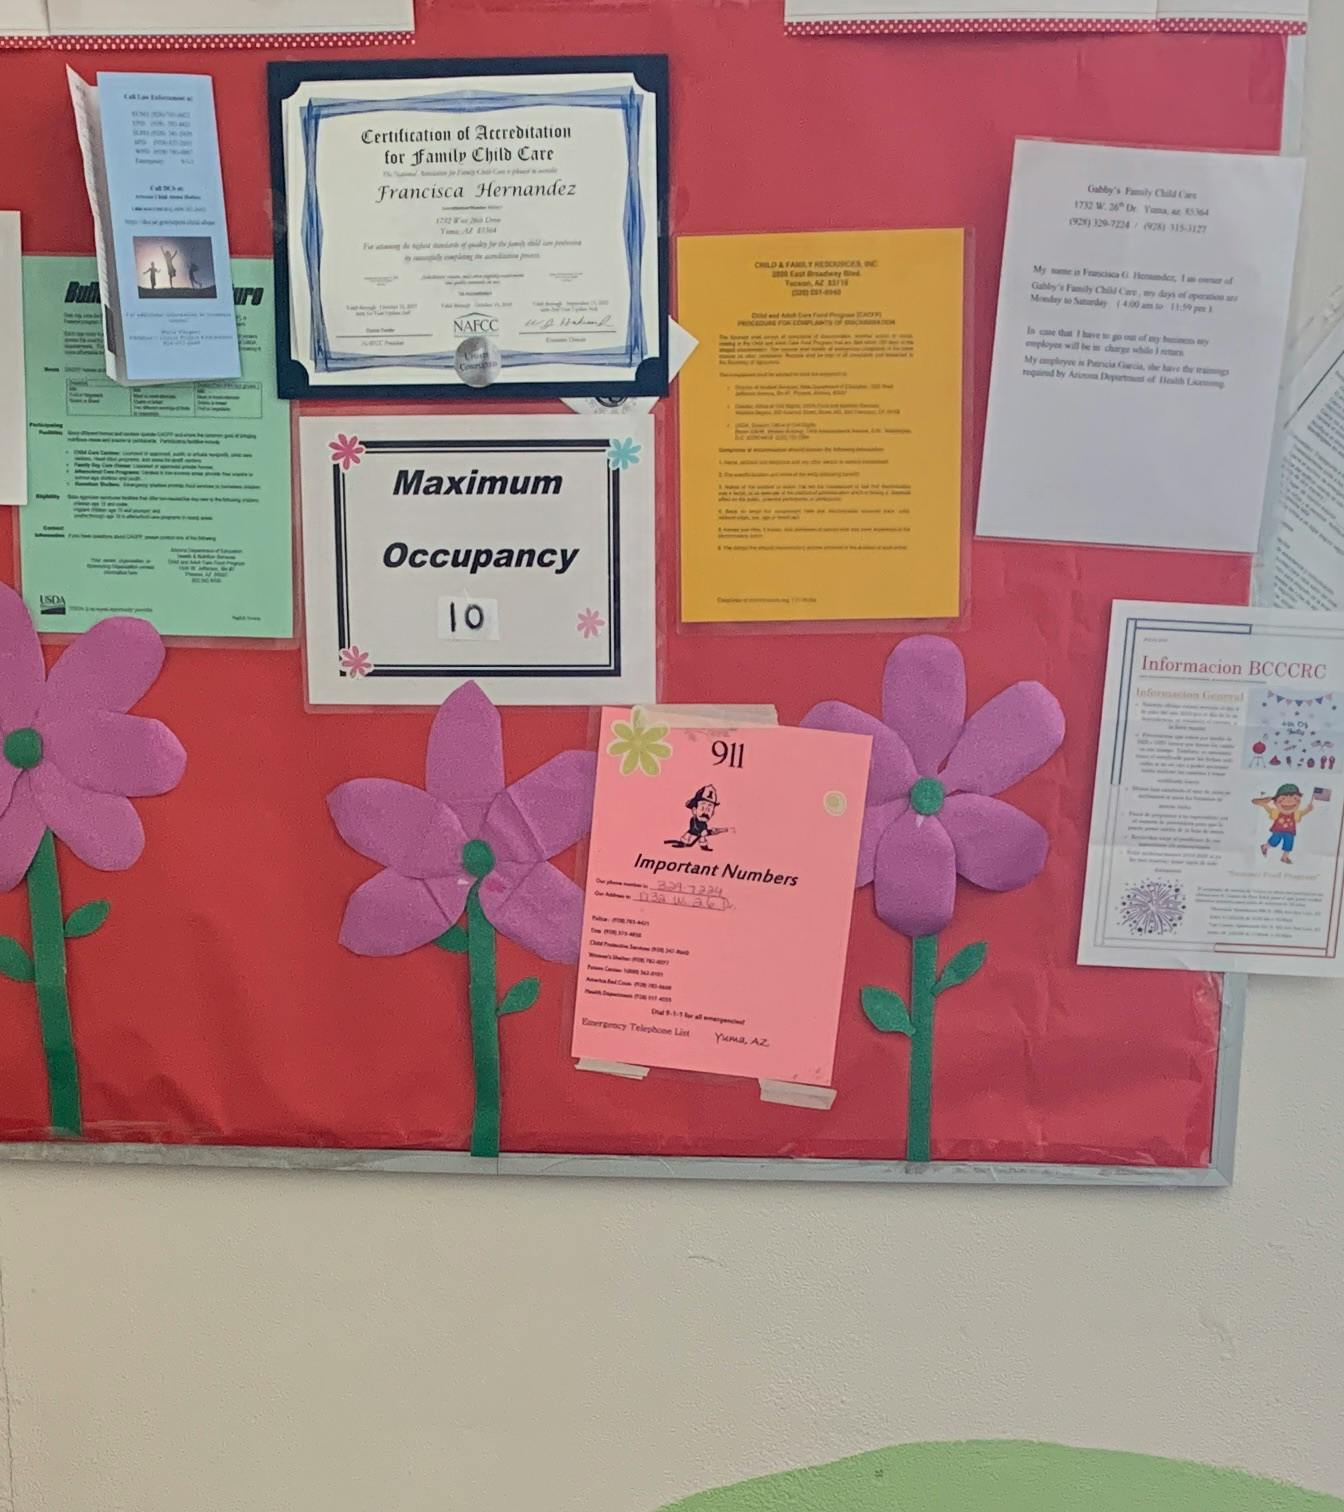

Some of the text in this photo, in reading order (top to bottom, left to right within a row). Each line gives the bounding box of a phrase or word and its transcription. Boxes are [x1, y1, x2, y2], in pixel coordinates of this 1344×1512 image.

[361, 125, 571, 144] Certification of Accreditation
[385, 146, 554, 167] for Family Child Care
[375, 178, 576, 203] Francisca Hernandez
[1087, 184, 1197, 200] Gabby's Family Child Care
[453, 319, 499, 332] NAFCC
[393, 469, 563, 495] Maximum
[383, 542, 580, 574] Occupancy
[40, 595, 66, 605] USDA
[450, 601, 484, 633] 10
[1141, 654, 1327, 681] Informacion BCCCRC
[1136, 687, 1245, 702] Informacion General
[710, 740, 744, 769] 911
[634, 853, 798, 888] Important Numbers
[582, 1017, 690, 1036] Emergency Telephone List
[715, 1032, 748, 1044] Yuma,
